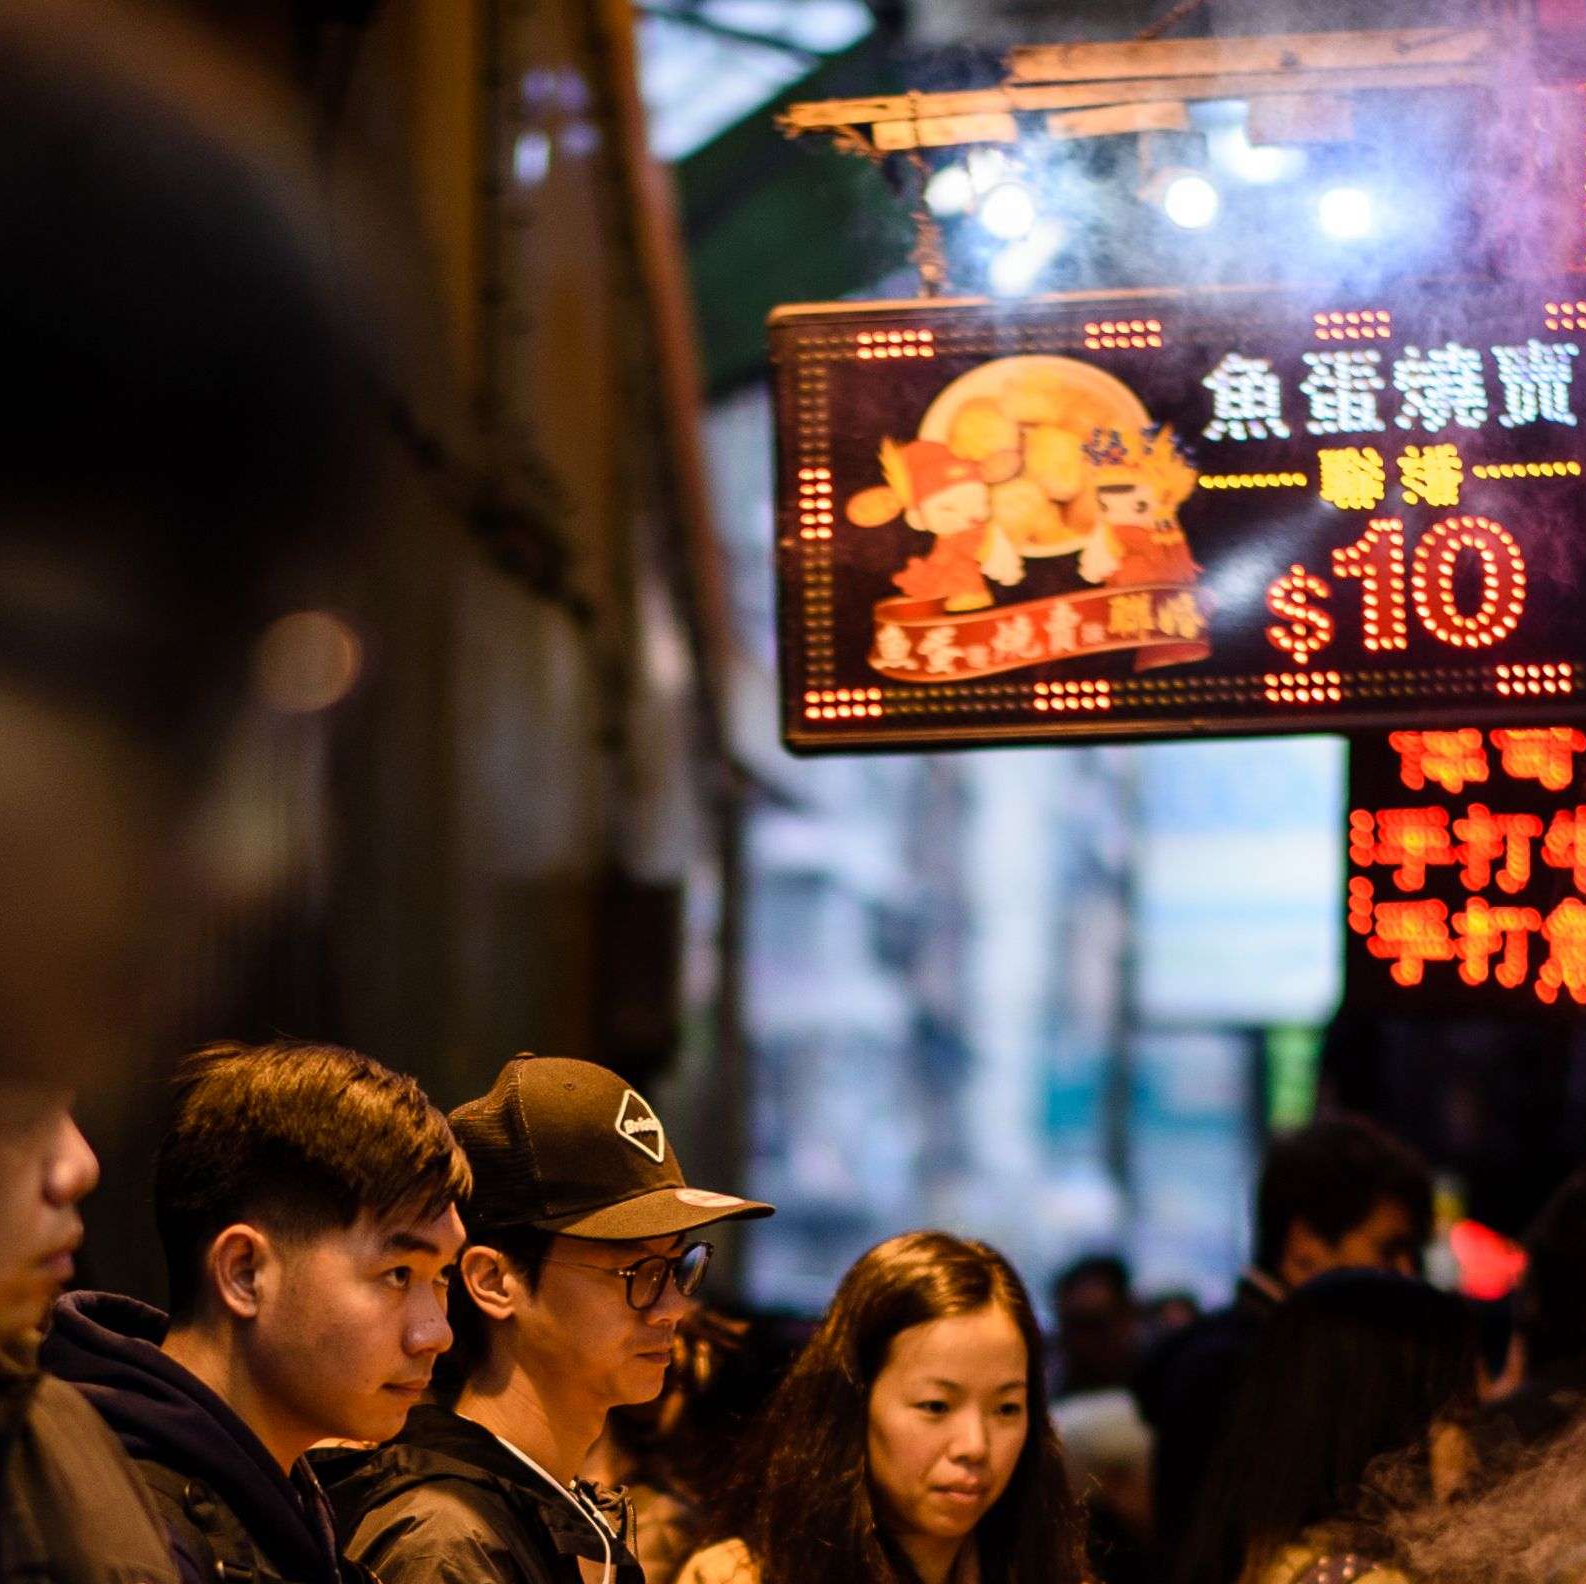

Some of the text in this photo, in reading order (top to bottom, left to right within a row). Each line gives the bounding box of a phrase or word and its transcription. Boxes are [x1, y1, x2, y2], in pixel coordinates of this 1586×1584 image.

[1201, 339, 1581, 441] 魚蛋燒賣
[1265, 515, 1526, 664] $10
